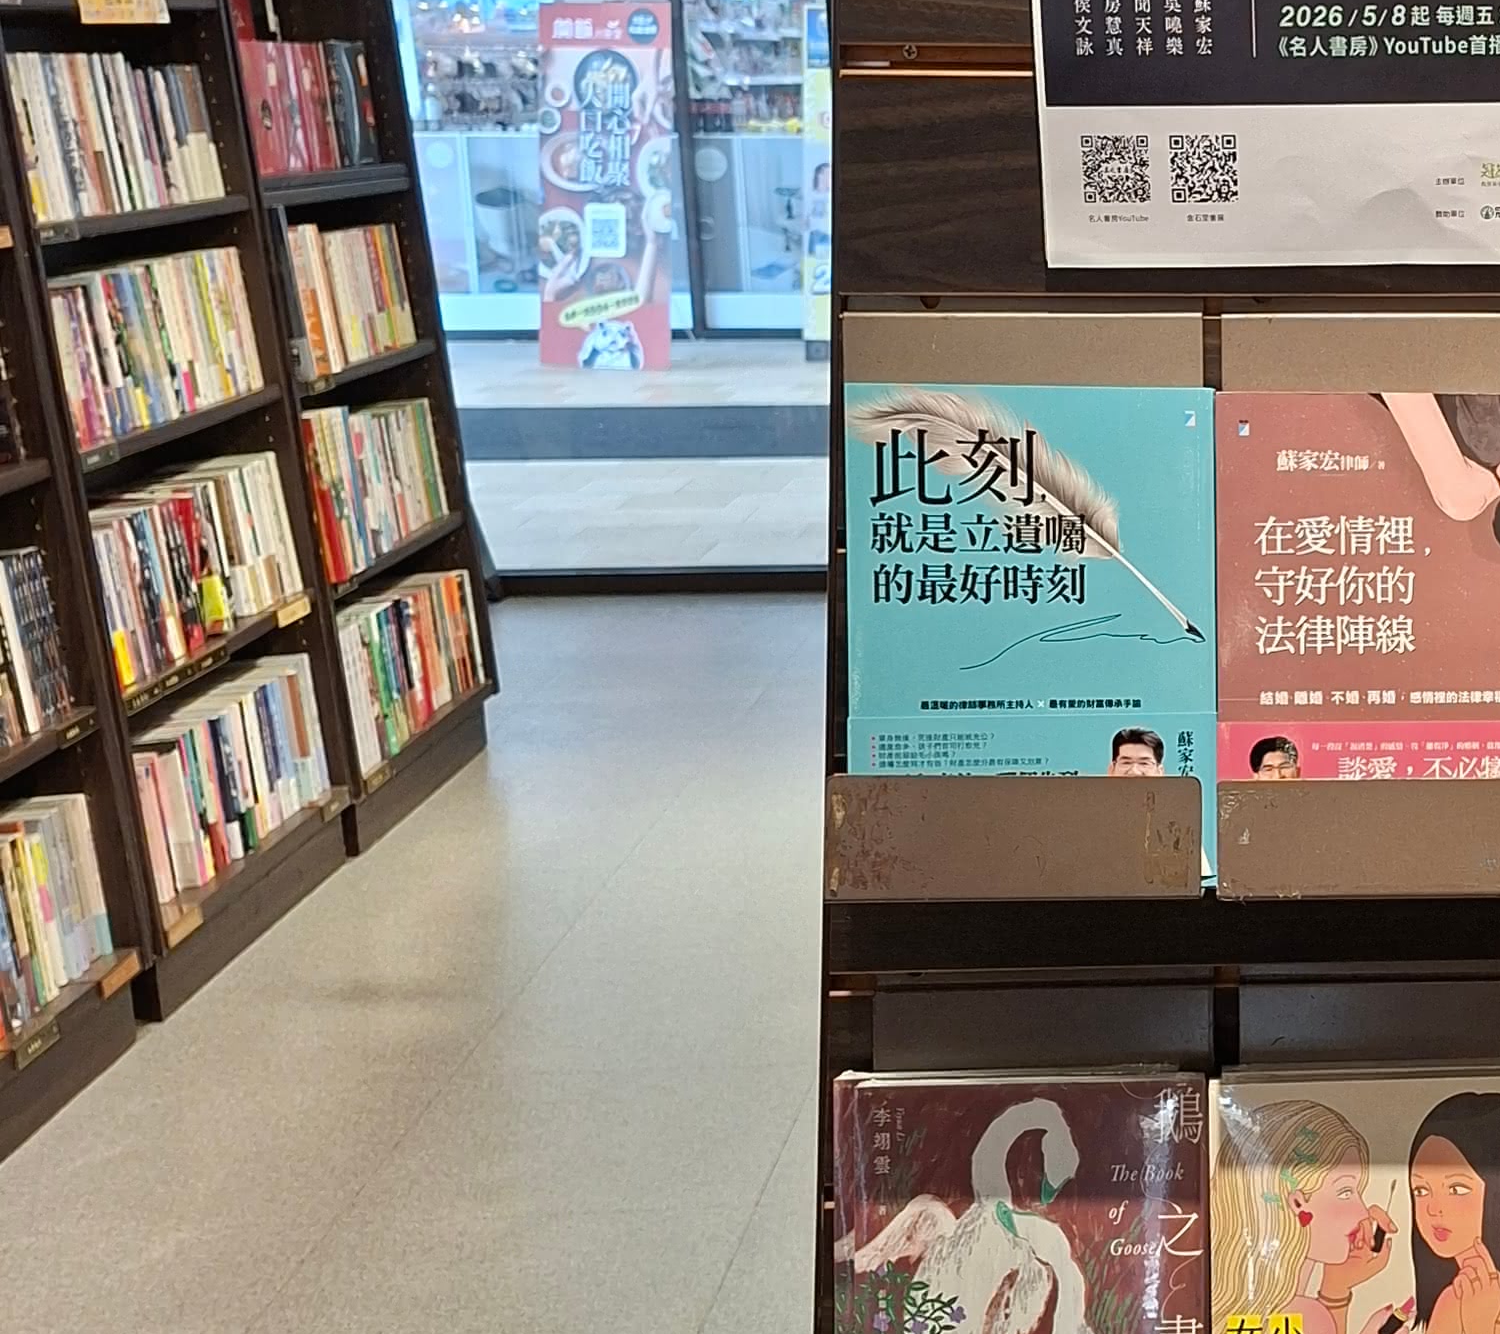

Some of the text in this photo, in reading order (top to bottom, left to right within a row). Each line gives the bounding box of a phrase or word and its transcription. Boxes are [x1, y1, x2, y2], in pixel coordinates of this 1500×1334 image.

[1410, 5, 1430, 26] 起
[1435, 5, 1495, 26] 每週五
[1277, 36, 1379, 57] 《名人書房》
[1276, 449, 1369, 471] 蘇家宏律師
[870, 512, 1087, 556] 就是立遺囑
[1253, 516, 1432, 557] 在愛情裡，
[872, 563, 1087, 606] 的最好時刻
[1254, 565, 1415, 606] 守好你的
[1255, 615, 1416, 655] 法律陣線
[1110, 1164, 1138, 1183] The
[1109, 1200, 1127, 1223] of
[1110, 1238, 1159, 1257] Goose
